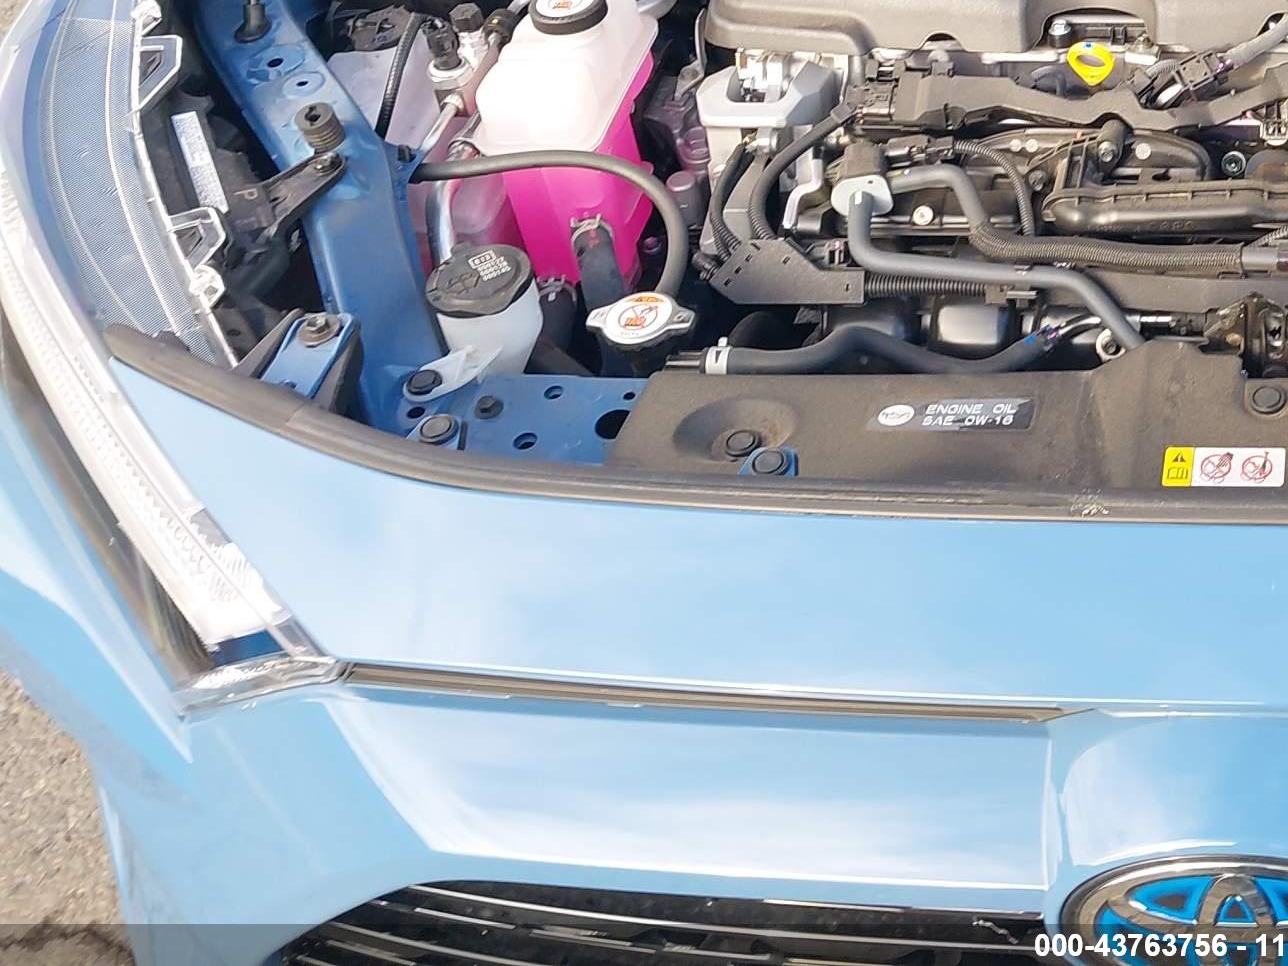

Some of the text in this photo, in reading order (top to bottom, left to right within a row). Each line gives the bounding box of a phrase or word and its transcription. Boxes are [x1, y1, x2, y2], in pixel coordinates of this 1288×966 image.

[924, 403, 1017, 415] ENGINE OIL
[921, 415, 955, 426] SAE
